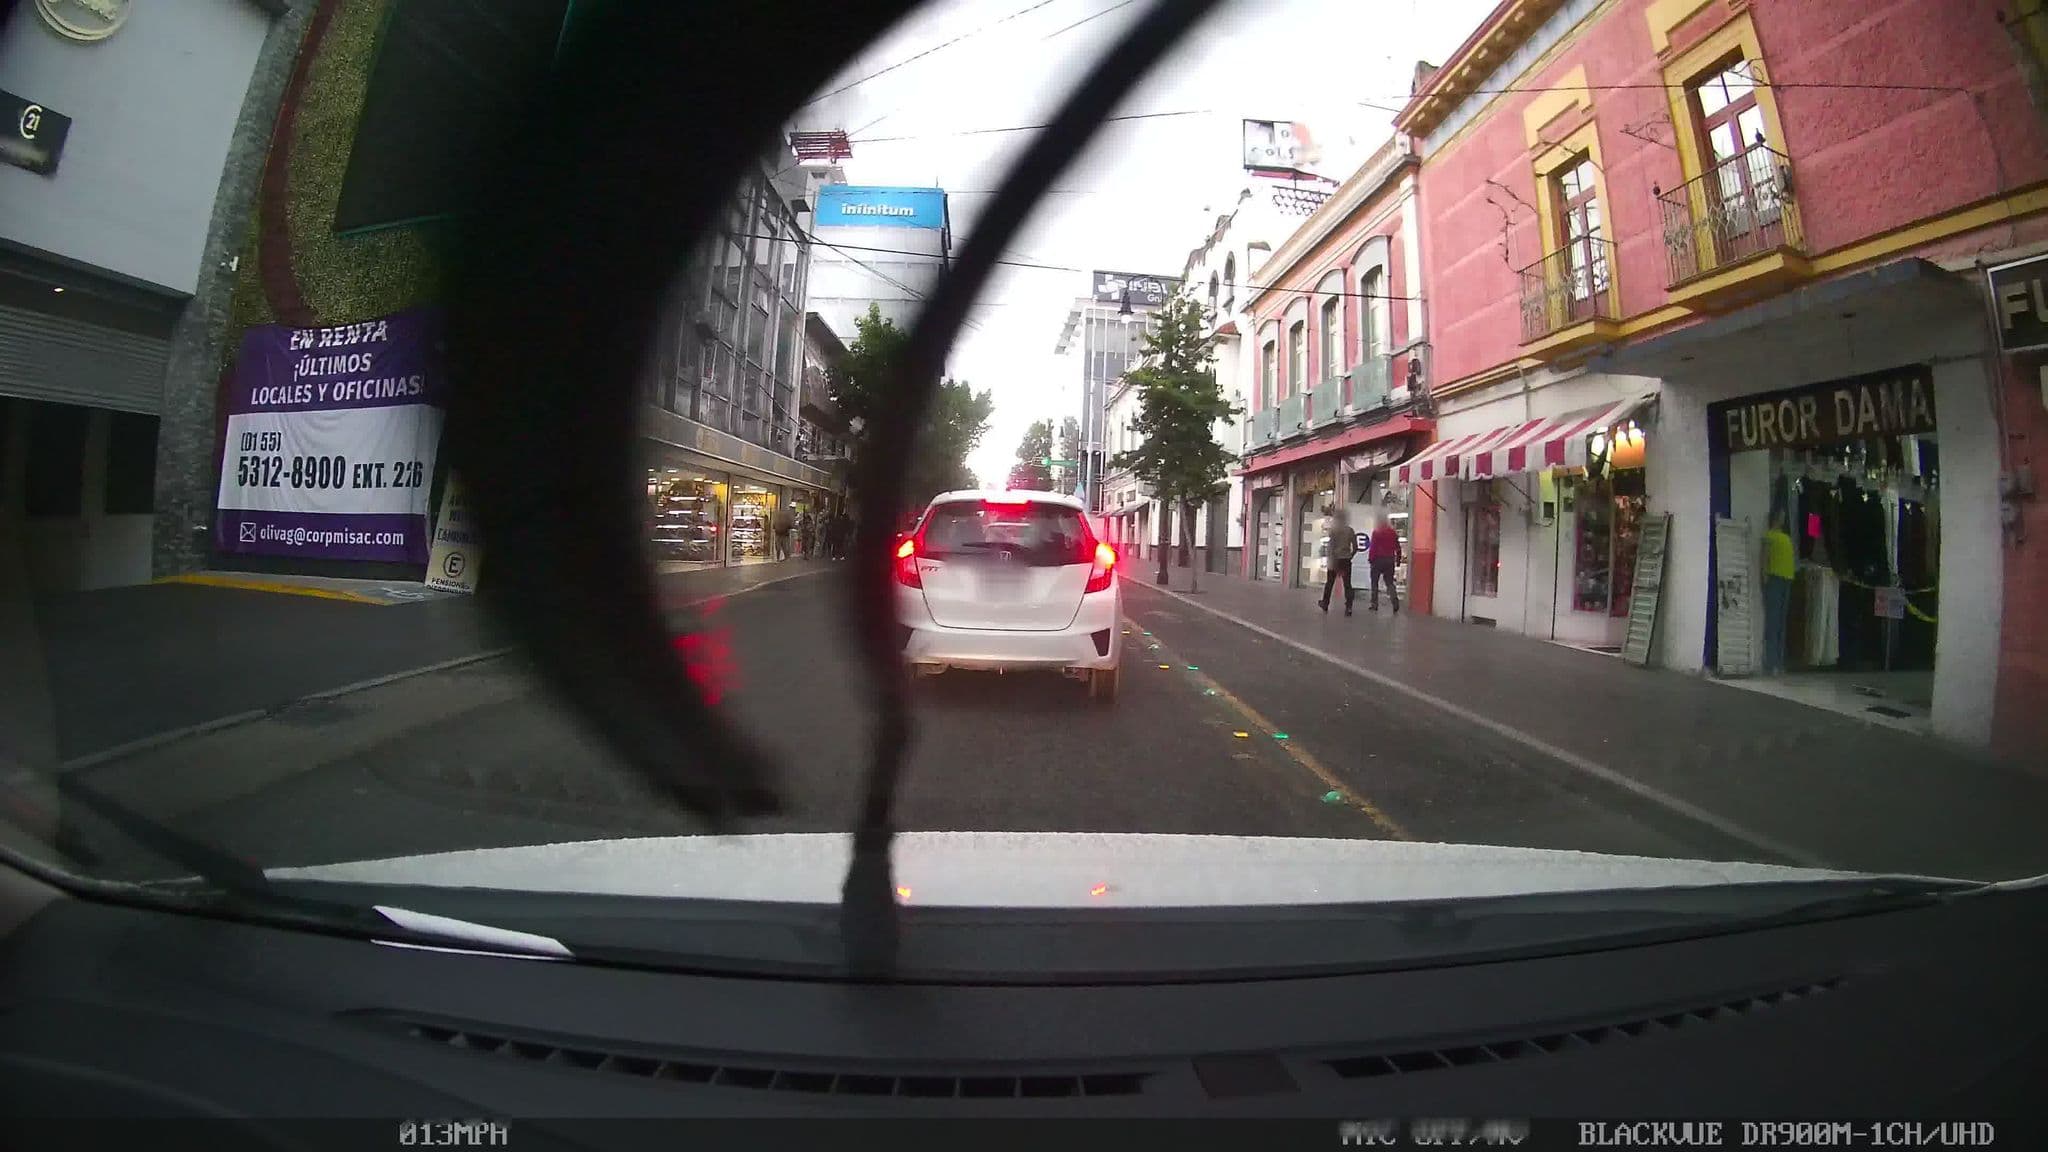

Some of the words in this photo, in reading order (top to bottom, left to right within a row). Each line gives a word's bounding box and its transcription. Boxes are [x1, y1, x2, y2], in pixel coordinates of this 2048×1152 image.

[841, 203, 914, 216] infinitum
[290, 329, 314, 351] EN
[318, 320, 388, 348] RENTA
[294, 352, 372, 382] ¡ÚLTIMOS
[251, 384, 312, 405] LOCALES
[318, 383, 329, 402] Y
[1727, 398, 1820, 449] FUROR
[1835, 378, 1933, 436] DAMA
[238, 455, 346, 489] 5312-8900
[352, 463, 387, 488] EXT.
[260, 524, 404, 547] olivag@corpmisac.com
